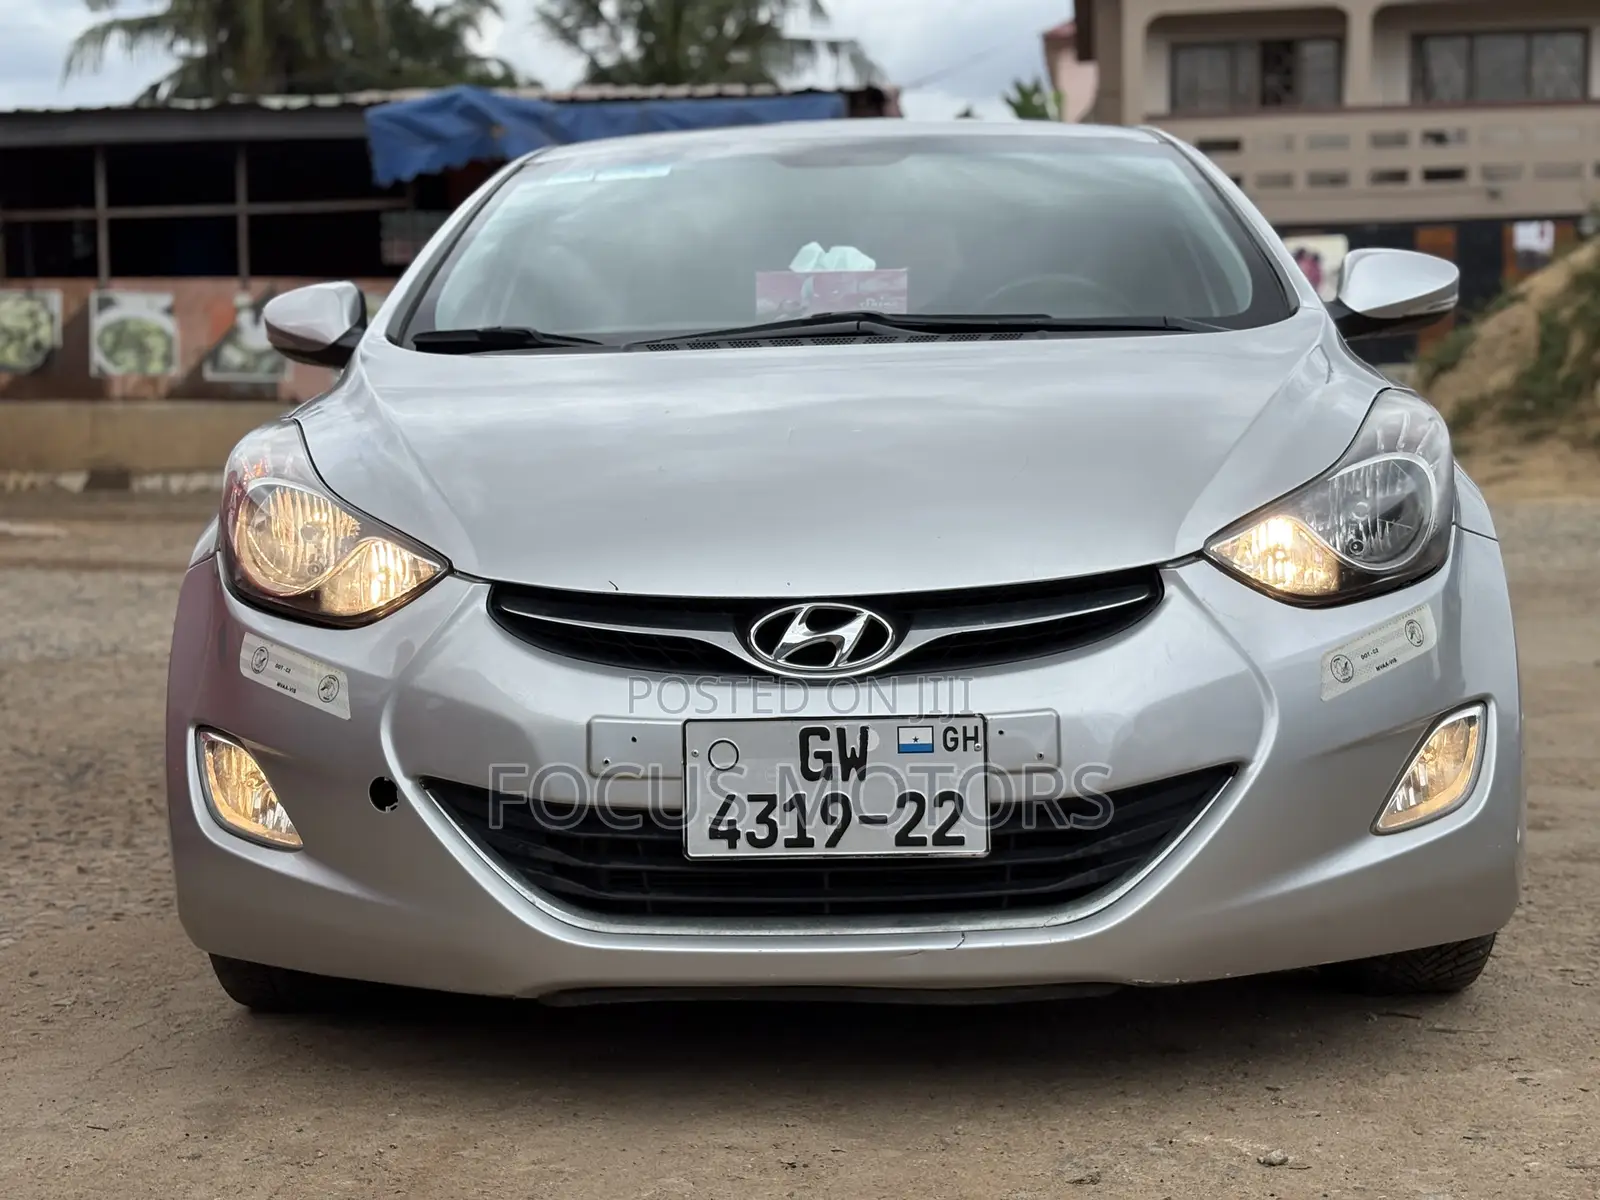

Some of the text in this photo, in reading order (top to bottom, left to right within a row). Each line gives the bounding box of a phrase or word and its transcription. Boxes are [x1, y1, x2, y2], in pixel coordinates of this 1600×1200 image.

[799, 725, 980, 782] GW GH
[707, 789, 966, 850] 4319-22
